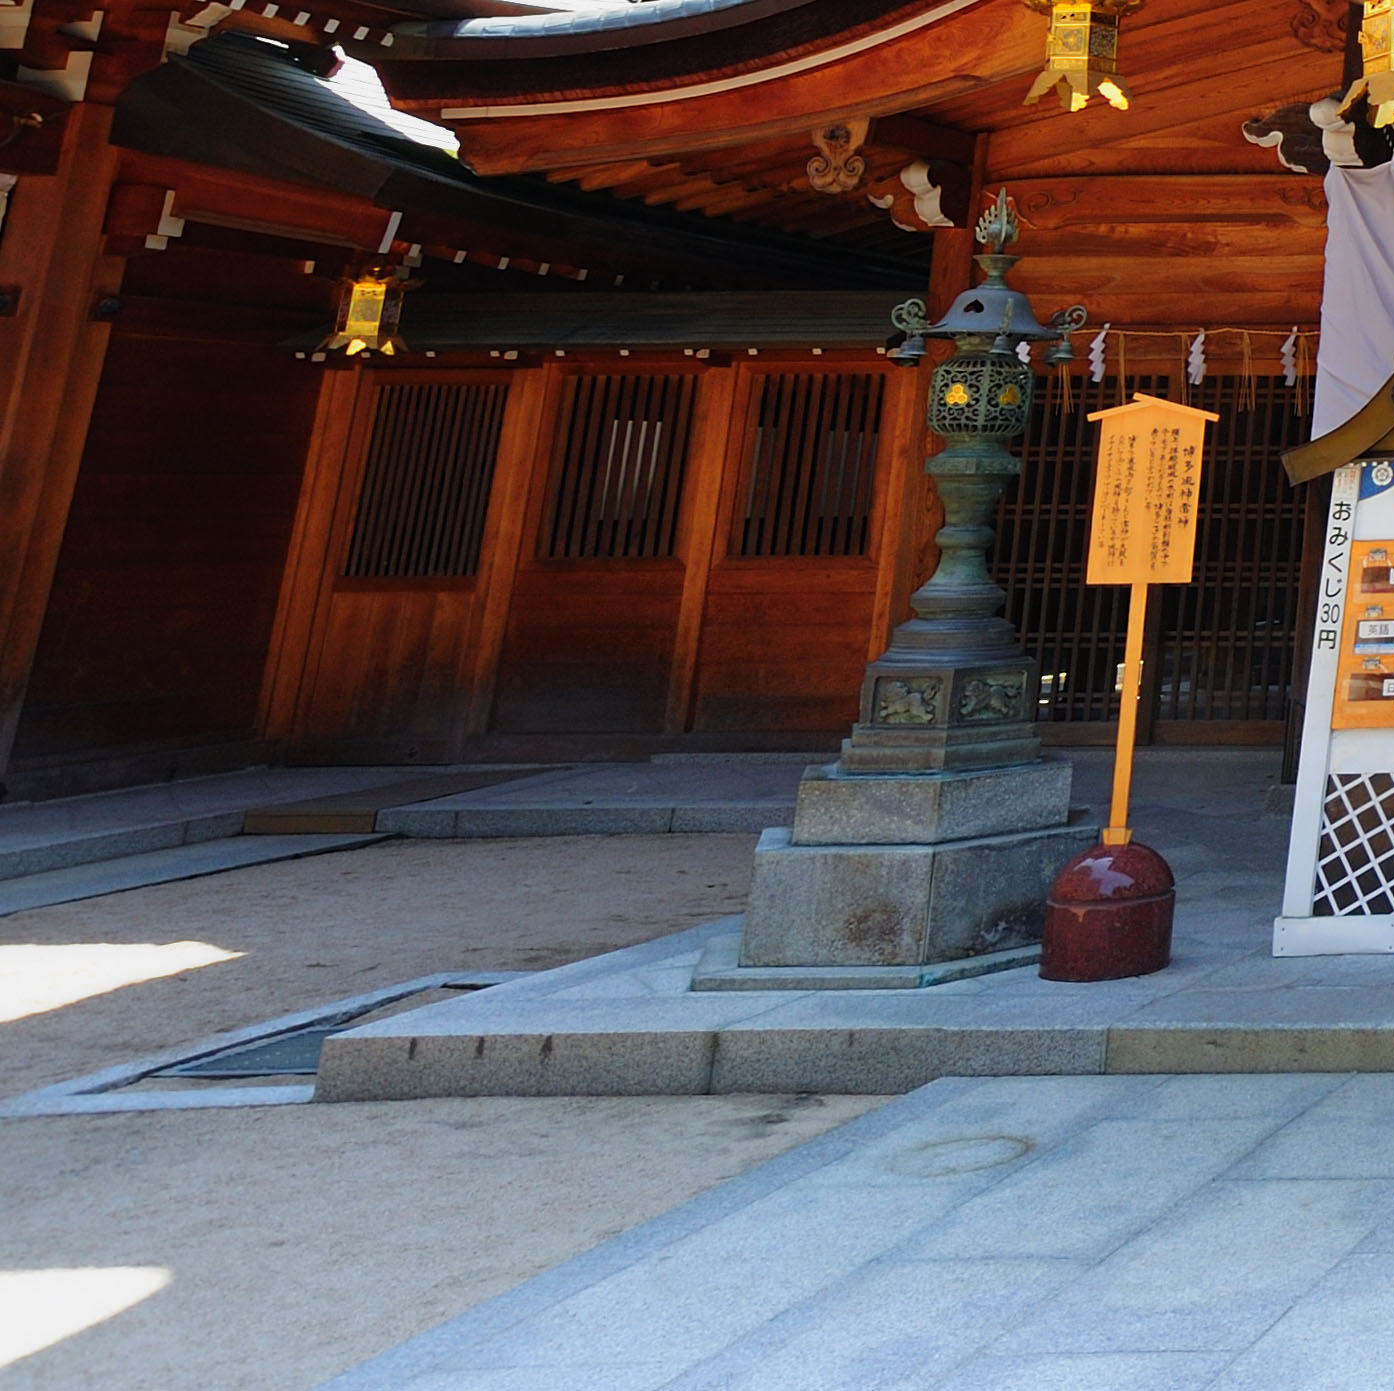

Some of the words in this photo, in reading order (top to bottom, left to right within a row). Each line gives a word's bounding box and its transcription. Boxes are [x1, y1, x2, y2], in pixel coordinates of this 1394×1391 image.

[1316, 500, 1352, 650] おみくじ30円
[1367, 623, 1390, 636] 英語
